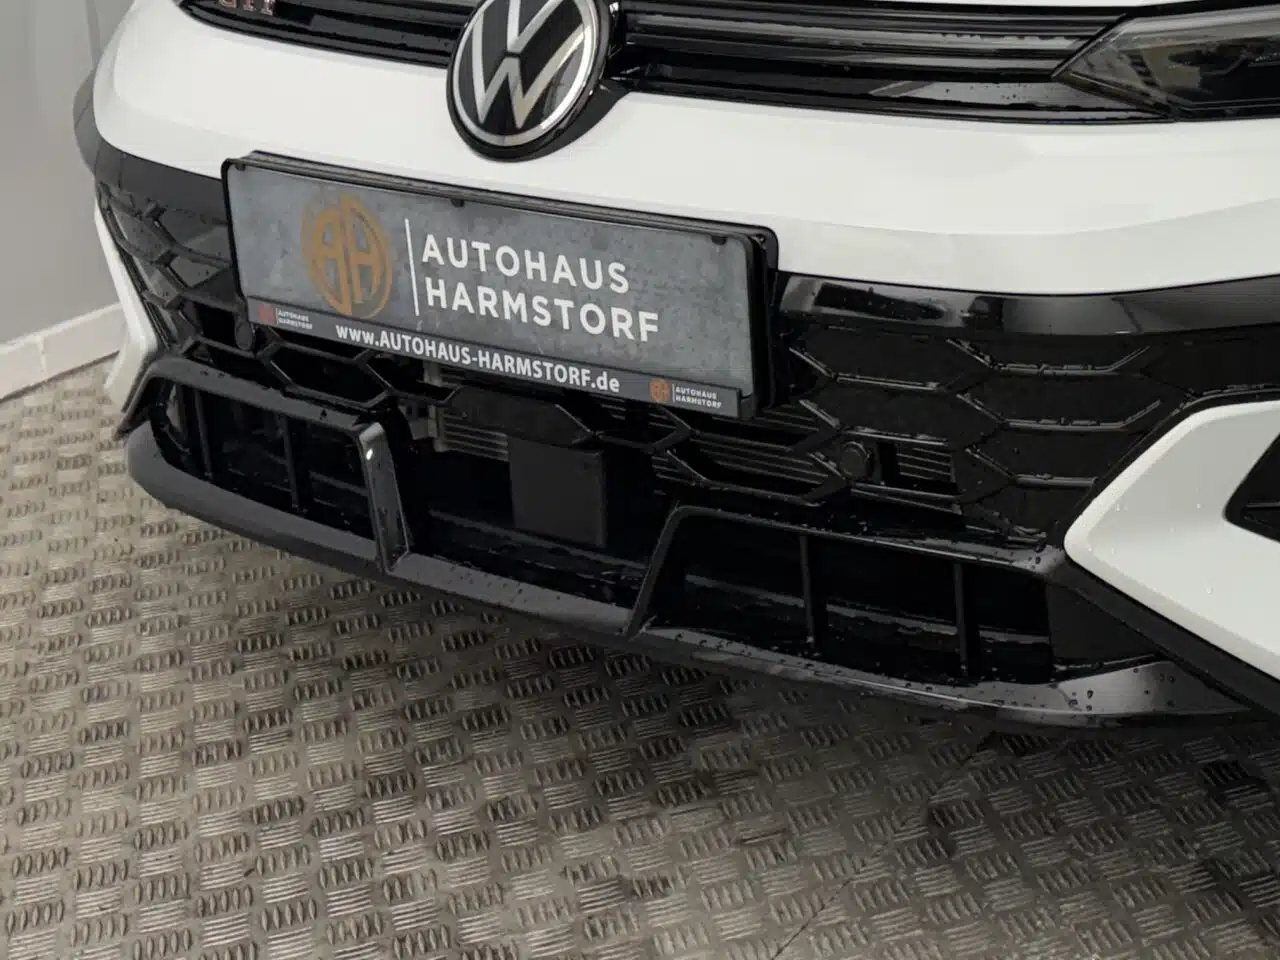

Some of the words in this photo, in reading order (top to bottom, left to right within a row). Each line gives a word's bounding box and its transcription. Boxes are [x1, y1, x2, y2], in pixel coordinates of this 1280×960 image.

[422, 234, 630, 294] AUTOHAUS
[425, 277, 660, 342] HARMSTORF
[335, 324, 621, 393] www.AUTOHAUS-HARMSTORF.de
[675, 386, 717, 400] AUTOHAUS
[675, 394, 722, 409] HARMSTORF
